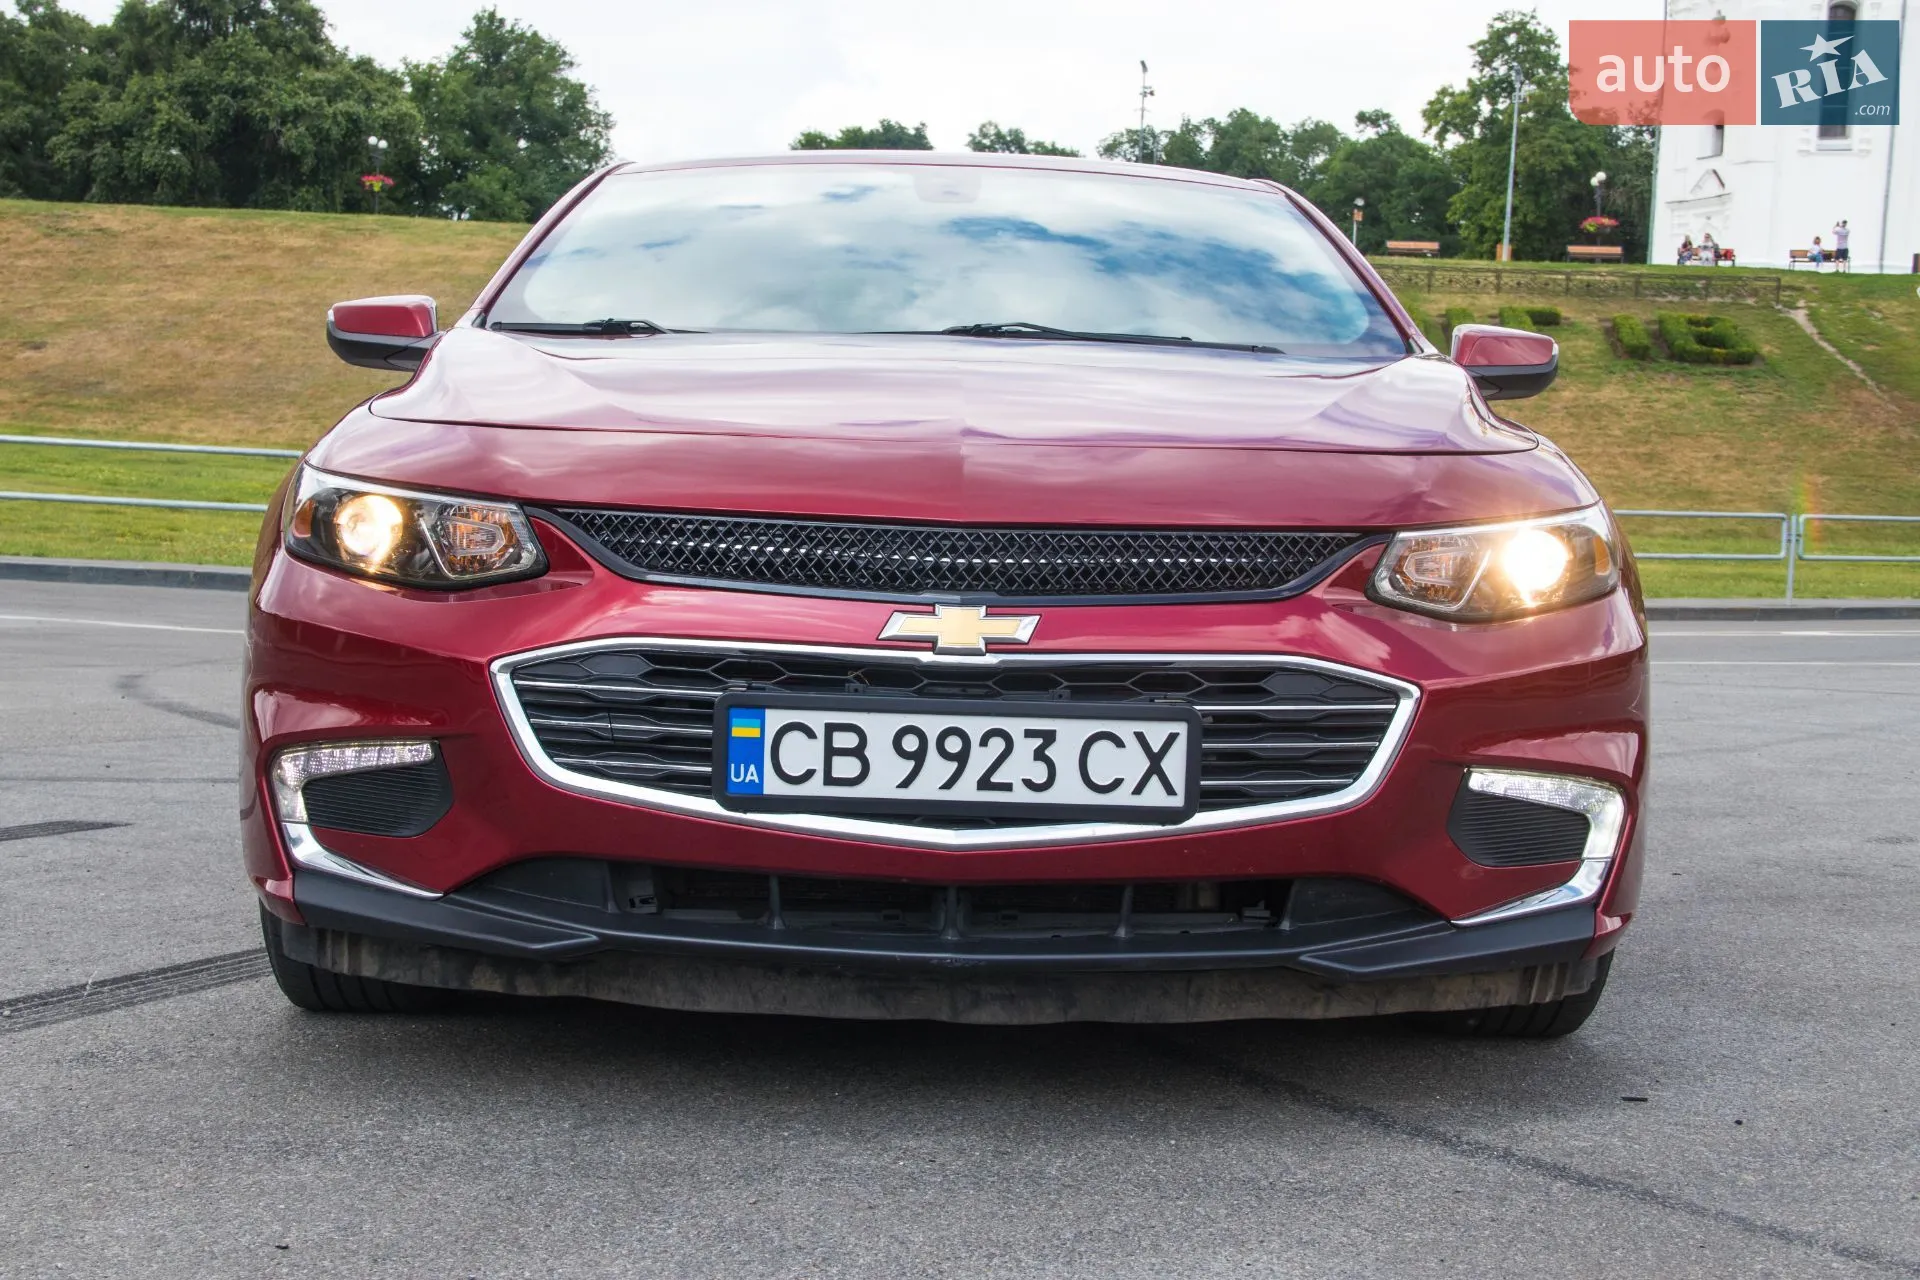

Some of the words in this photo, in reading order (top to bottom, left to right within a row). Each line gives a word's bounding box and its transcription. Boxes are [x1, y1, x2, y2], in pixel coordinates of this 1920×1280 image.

[730, 764, 760, 784] UA
[770, 721, 871, 787] CB
[892, 724, 1057, 793] 9923
[1078, 730, 1181, 796] CX
